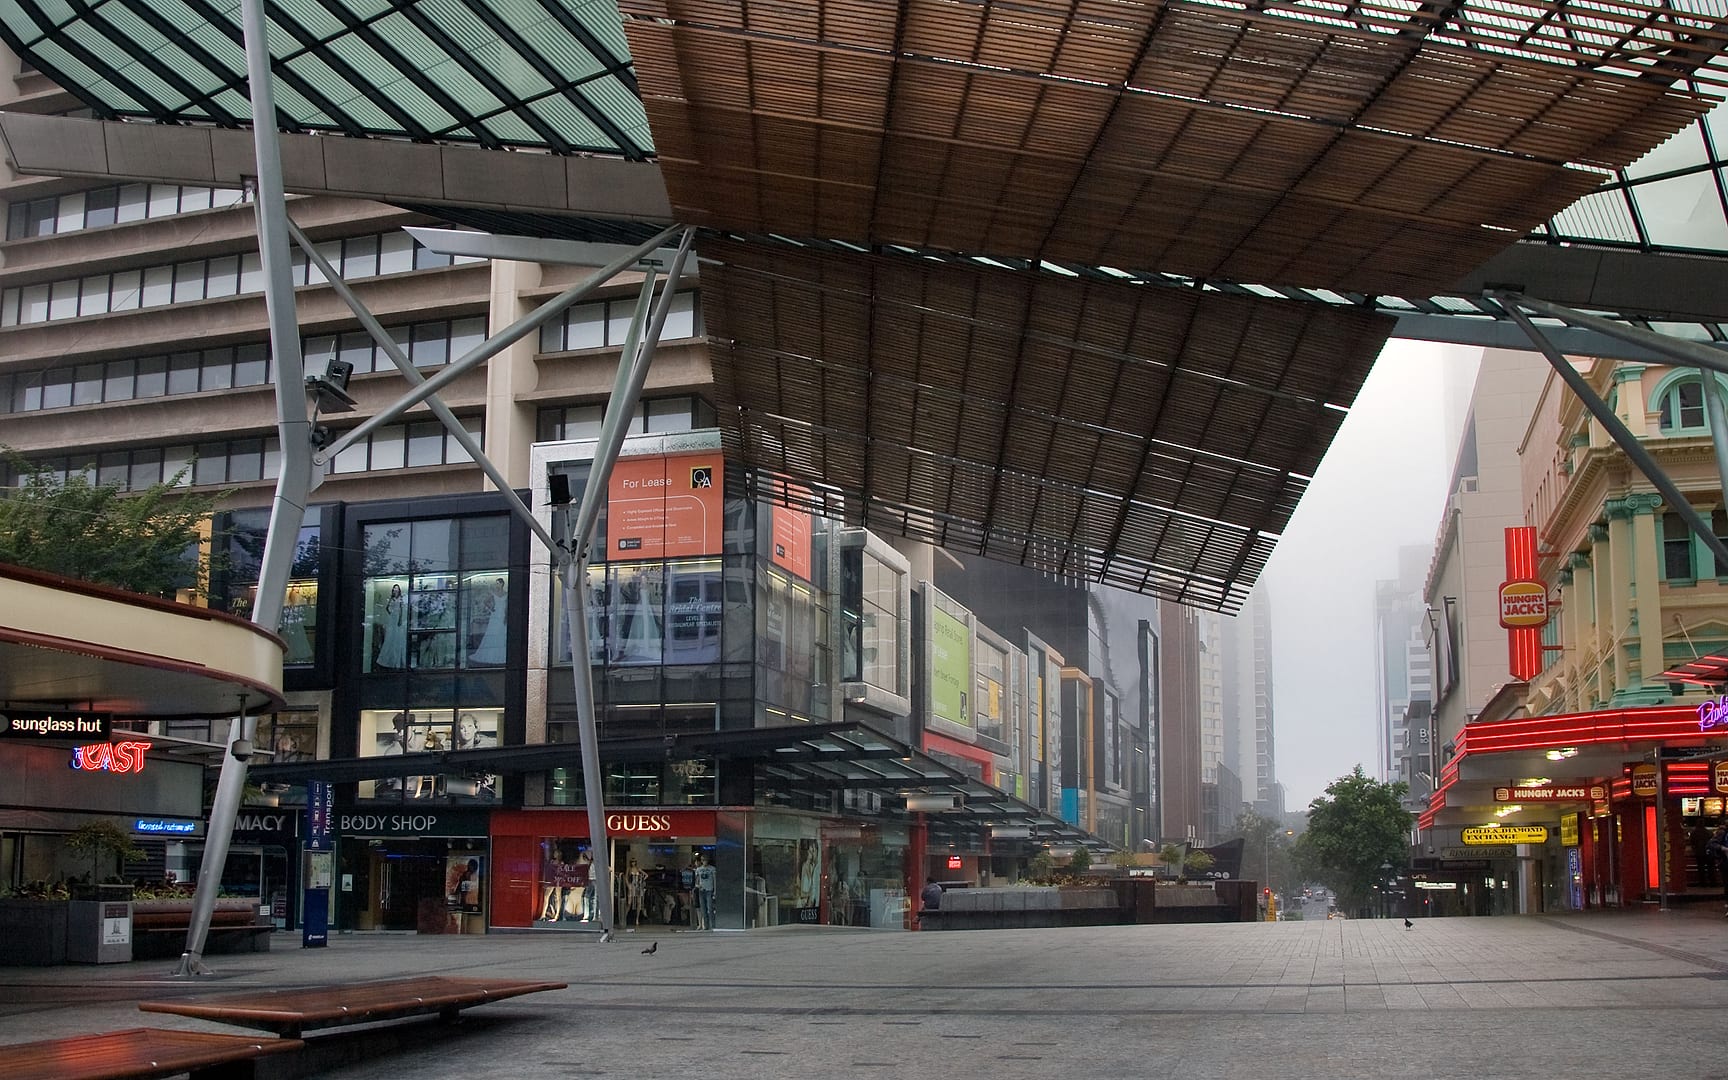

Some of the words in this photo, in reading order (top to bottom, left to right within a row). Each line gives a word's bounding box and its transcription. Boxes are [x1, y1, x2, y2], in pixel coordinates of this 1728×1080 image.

[623, 479, 640, 489] For
[642, 477, 672, 488] Lease
[232, 597, 248, 608] The
[1503, 594, 1544, 604] HUNGRY
[12, 716, 75, 735] sunglass
[77, 717, 102, 733] hut
[1514, 789, 1554, 798] HUNGRY
[323, 783, 333, 836] Transport
[341, 815, 388, 831] BODY
[391, 814, 437, 831] SHOP
[607, 814, 671, 831] GUESS
[800, 909, 818, 921] GUESS
